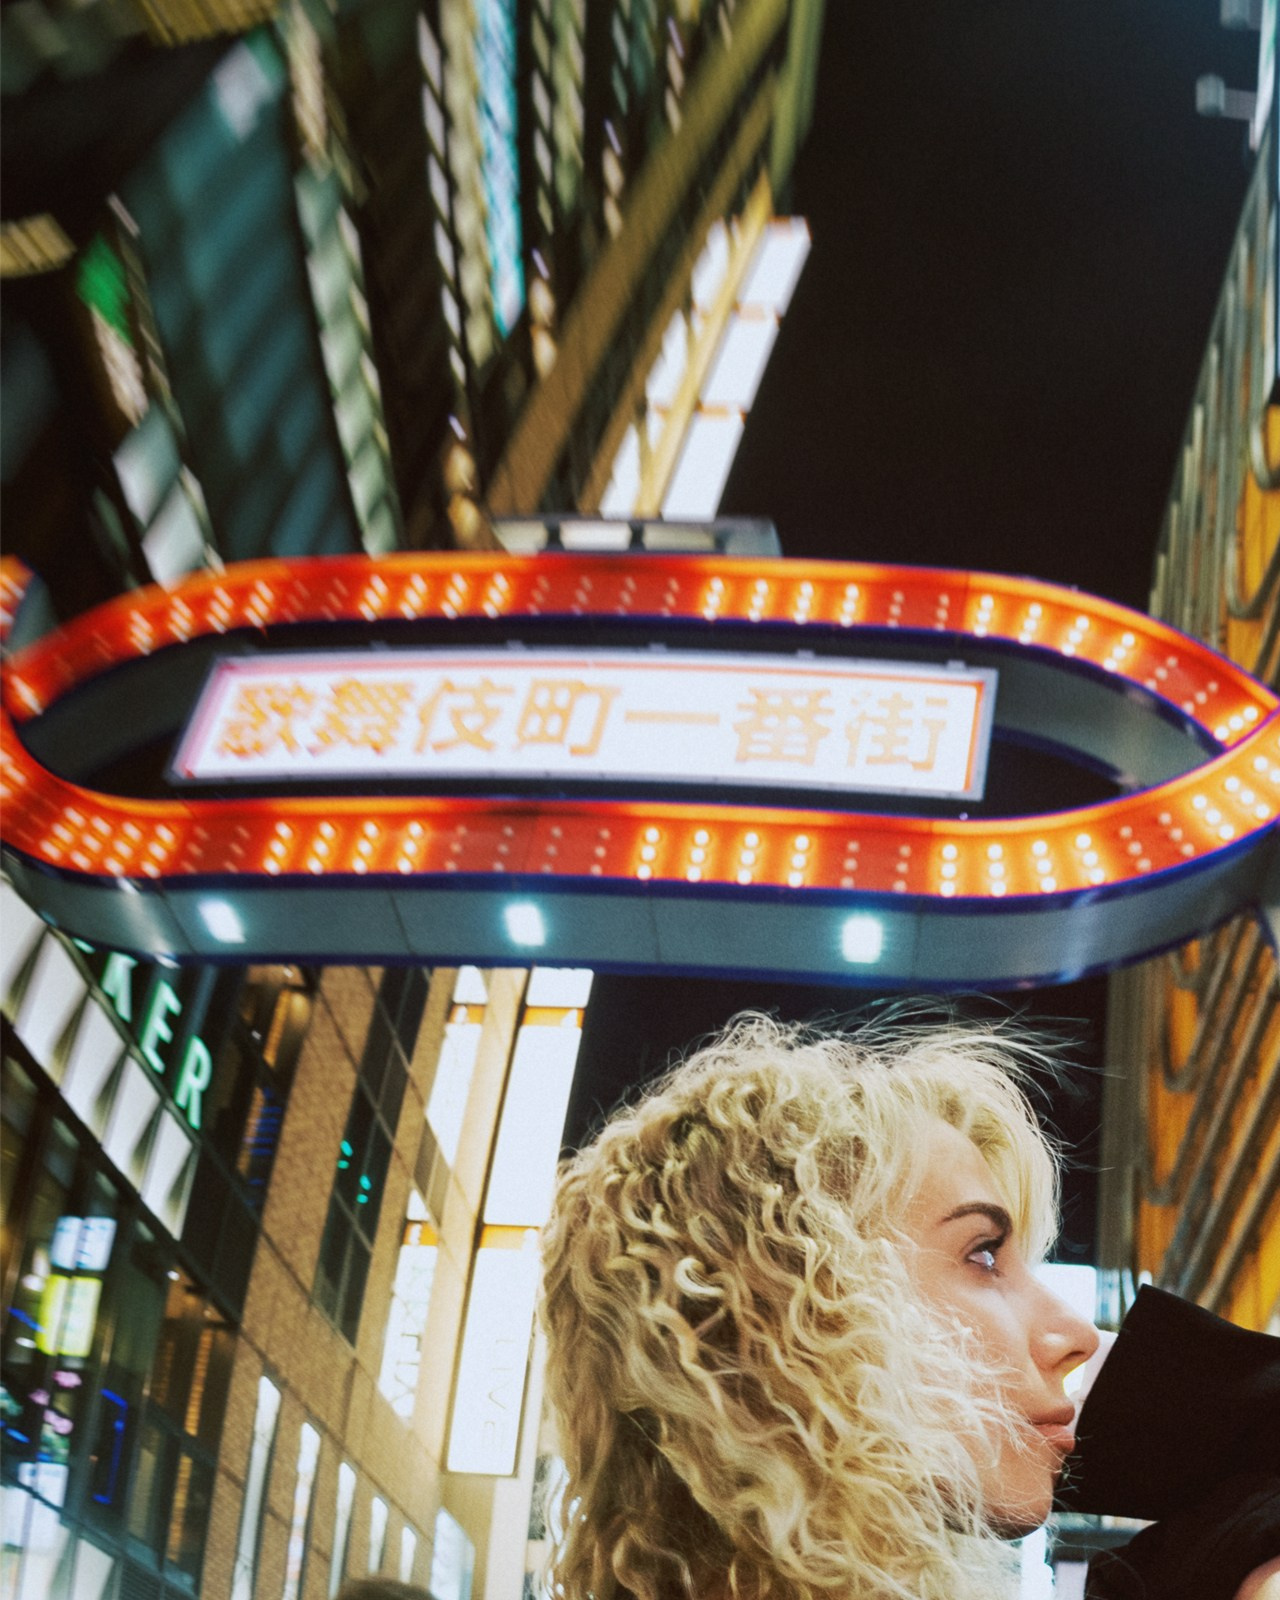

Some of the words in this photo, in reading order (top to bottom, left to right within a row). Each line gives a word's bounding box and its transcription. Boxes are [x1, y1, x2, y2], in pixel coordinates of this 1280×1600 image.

[214, 677, 949, 771] 歌舞伎町一番街
